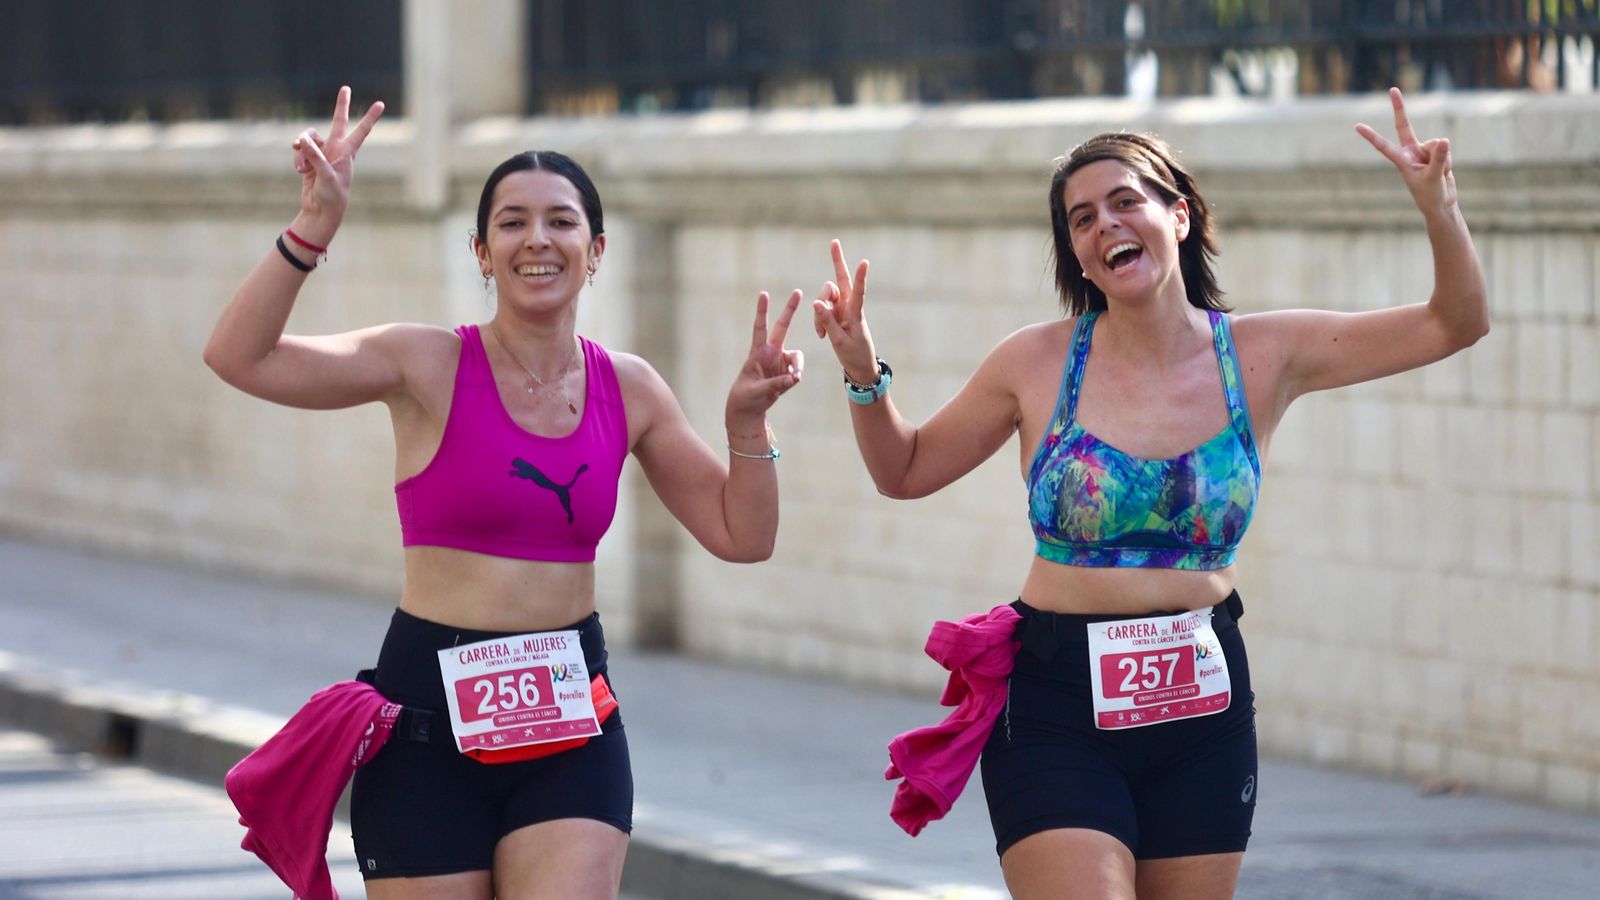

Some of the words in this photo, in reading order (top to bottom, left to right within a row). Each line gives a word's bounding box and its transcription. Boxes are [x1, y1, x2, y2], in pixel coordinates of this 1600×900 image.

[1107, 623, 1158, 640] CARRERA
[1172, 614, 1201, 635] MUJERES
[459, 643, 511, 665] CARRERA
[523, 636, 567, 653] MUJERES
[485, 659, 504, 668] CONTRA
[504, 657, 510, 665] EL
[1118, 652, 1180, 691] 257
[1199, 665, 1223, 679] #porellas
[473, 672, 540, 715] 256
[559, 690, 585, 701] #porellas
[1138, 694, 1155, 702] UNIDOS
[1155, 692, 1173, 700] CONTRA
[498, 714, 517, 723] UNIDOS
[517, 712, 535, 720] CONTRA
